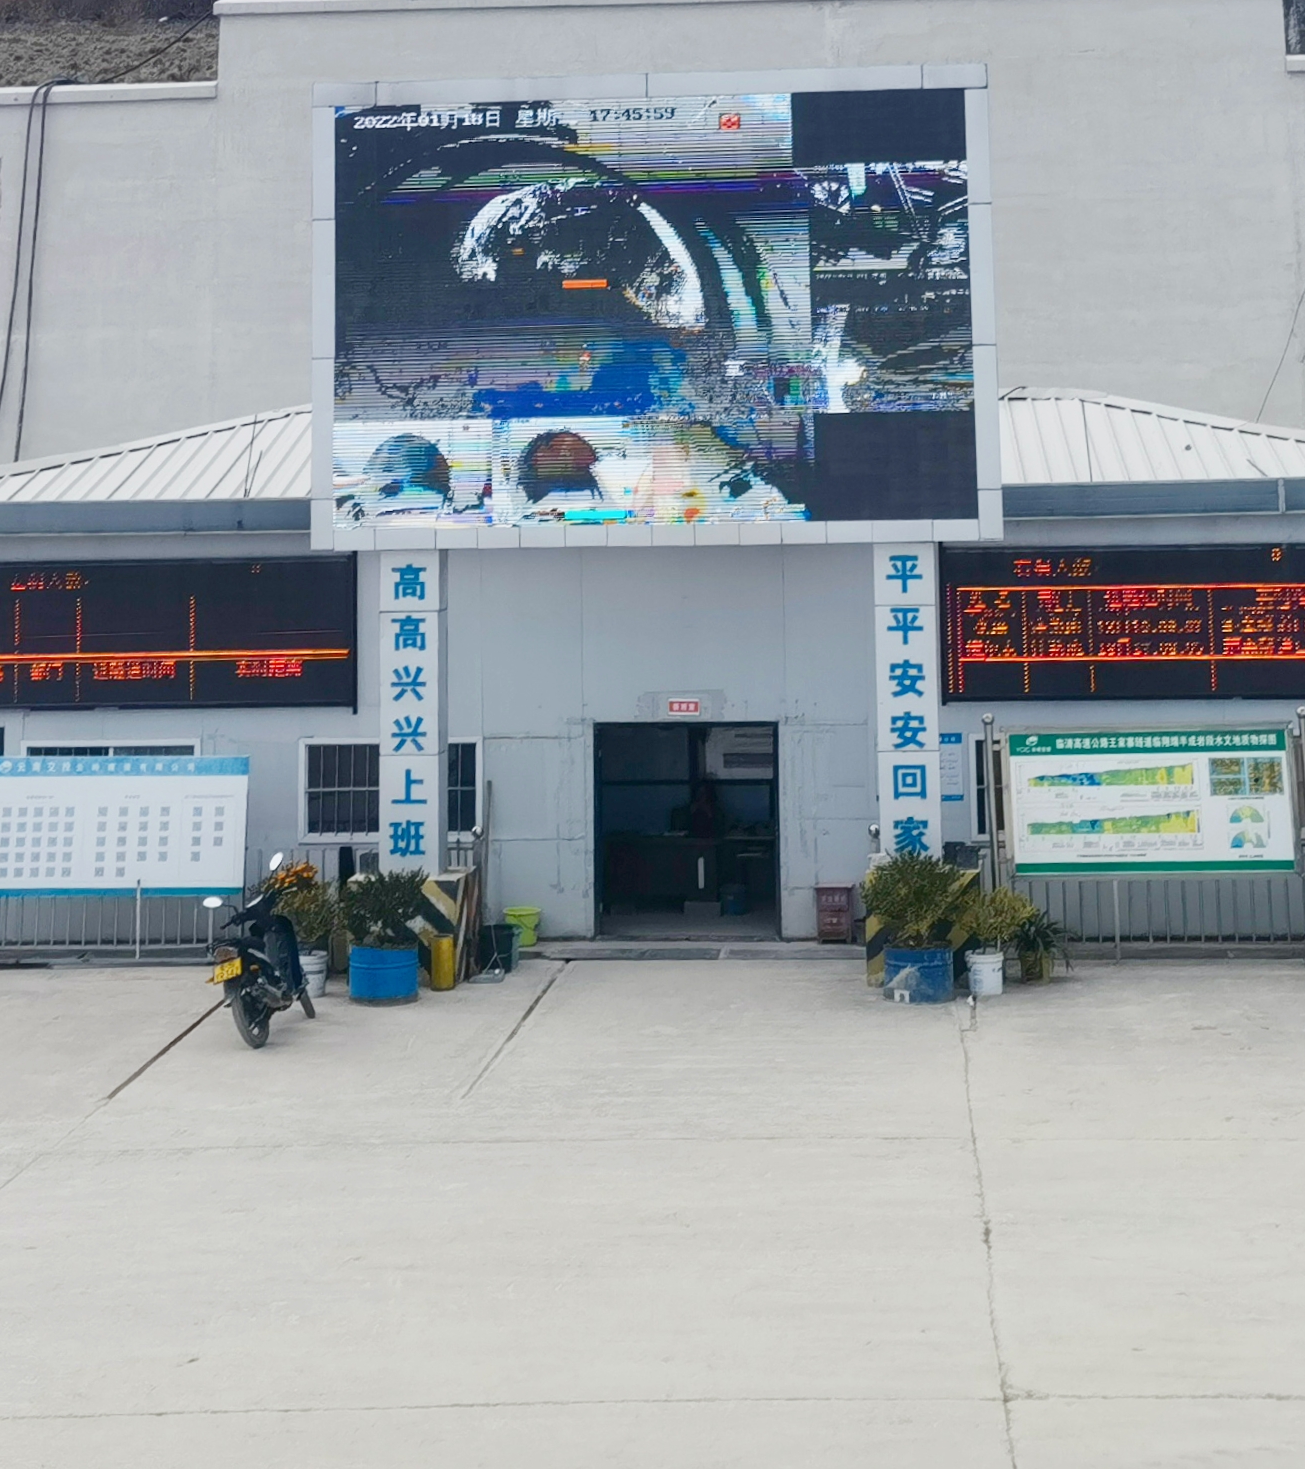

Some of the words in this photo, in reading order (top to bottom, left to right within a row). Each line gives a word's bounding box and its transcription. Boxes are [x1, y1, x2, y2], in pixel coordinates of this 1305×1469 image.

[389, 564, 427, 857] 高高兴兴上班
[886, 555, 929, 854] 平平安安回家
